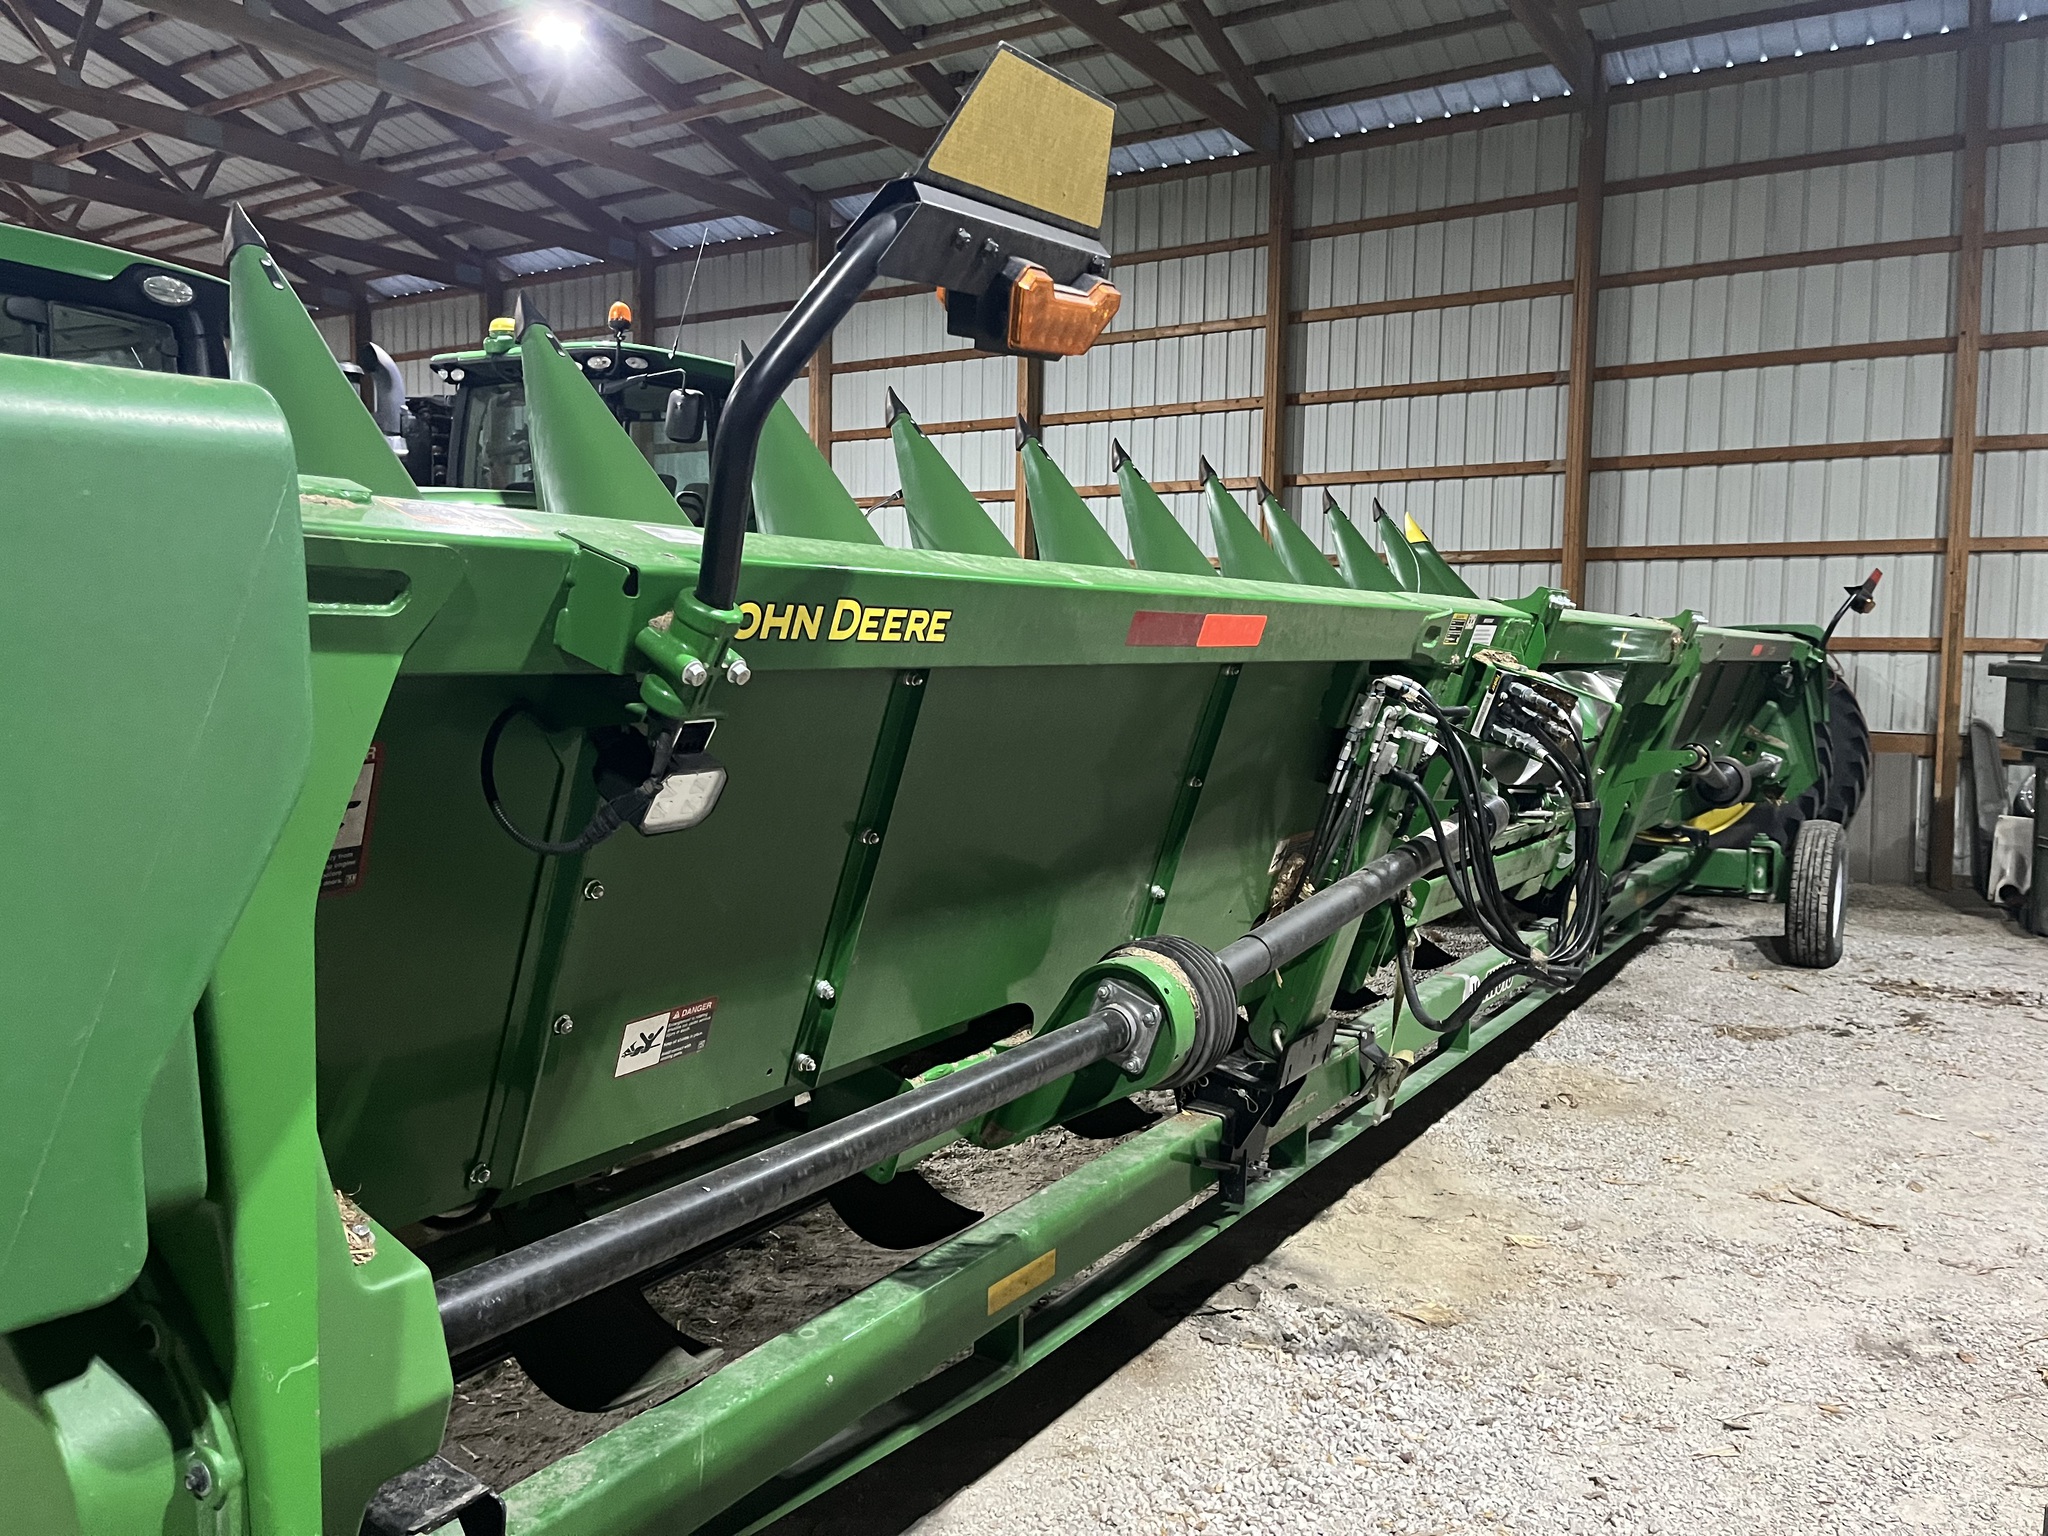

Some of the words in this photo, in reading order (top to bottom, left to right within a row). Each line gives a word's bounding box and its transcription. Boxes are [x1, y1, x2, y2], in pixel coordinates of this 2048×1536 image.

[734, 602, 824, 641] OHN
[828, 598, 953, 642] DEERE
[681, 1001, 713, 1018] DANGER
